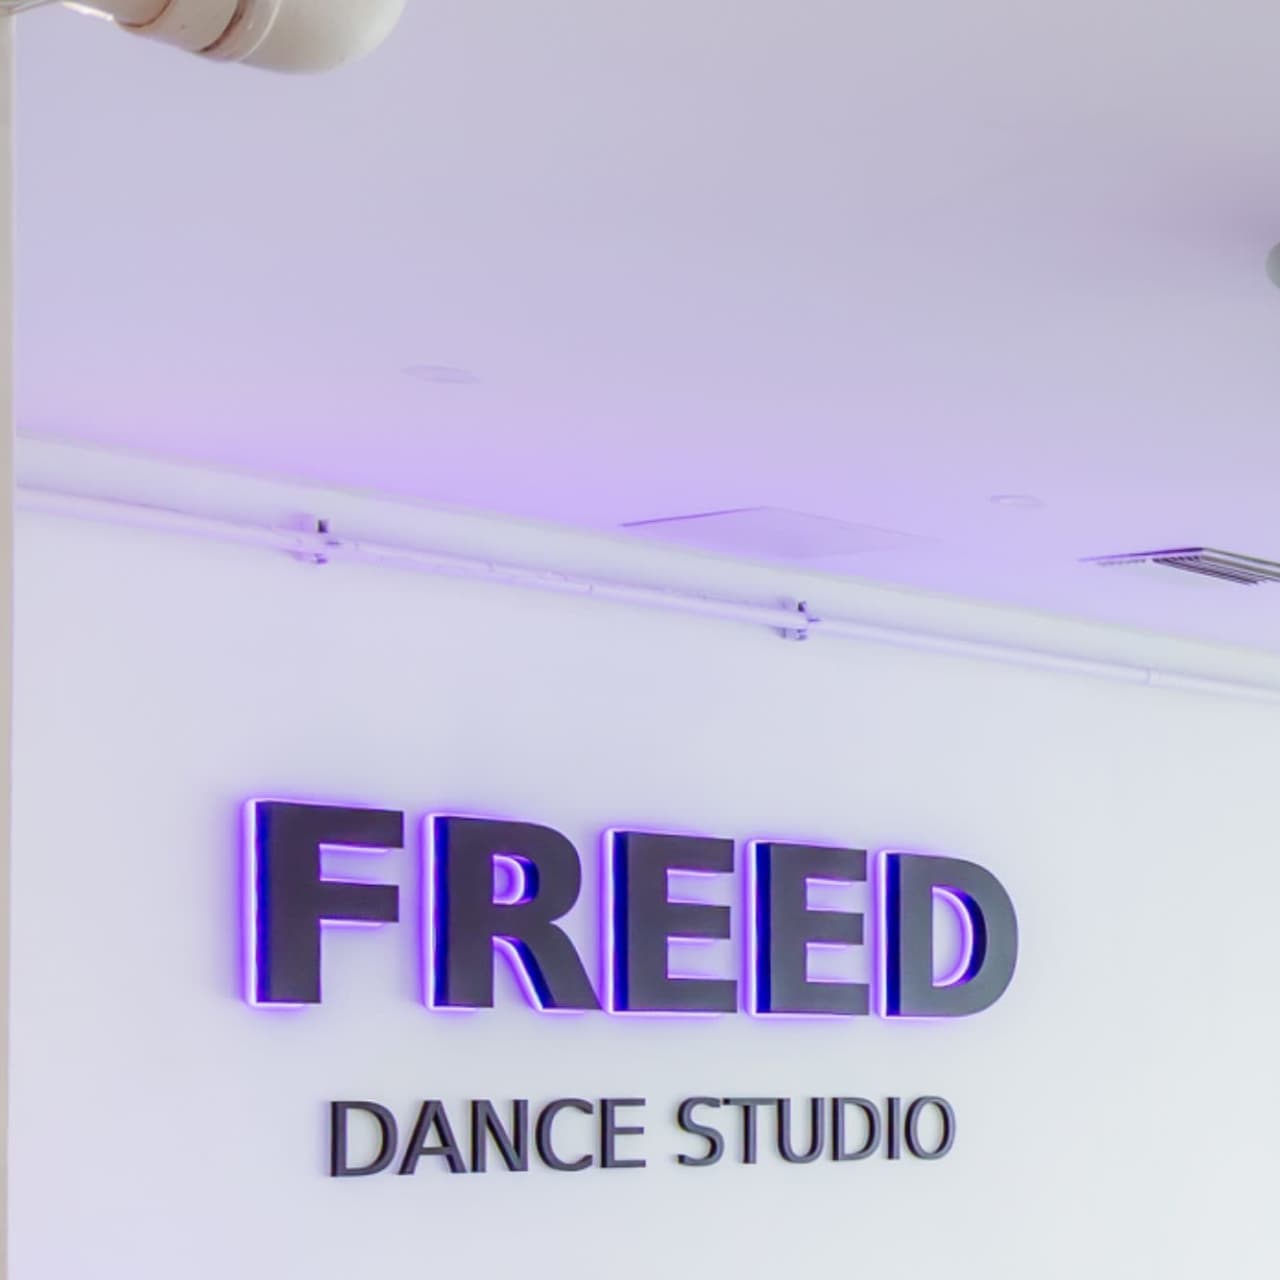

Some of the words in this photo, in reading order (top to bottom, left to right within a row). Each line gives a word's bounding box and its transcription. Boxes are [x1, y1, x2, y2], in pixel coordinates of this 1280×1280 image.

[244, 798, 1018, 1018] FREED
[329, 1098, 647, 1177] DANCE
[675, 1095, 957, 1166] STUDIO
